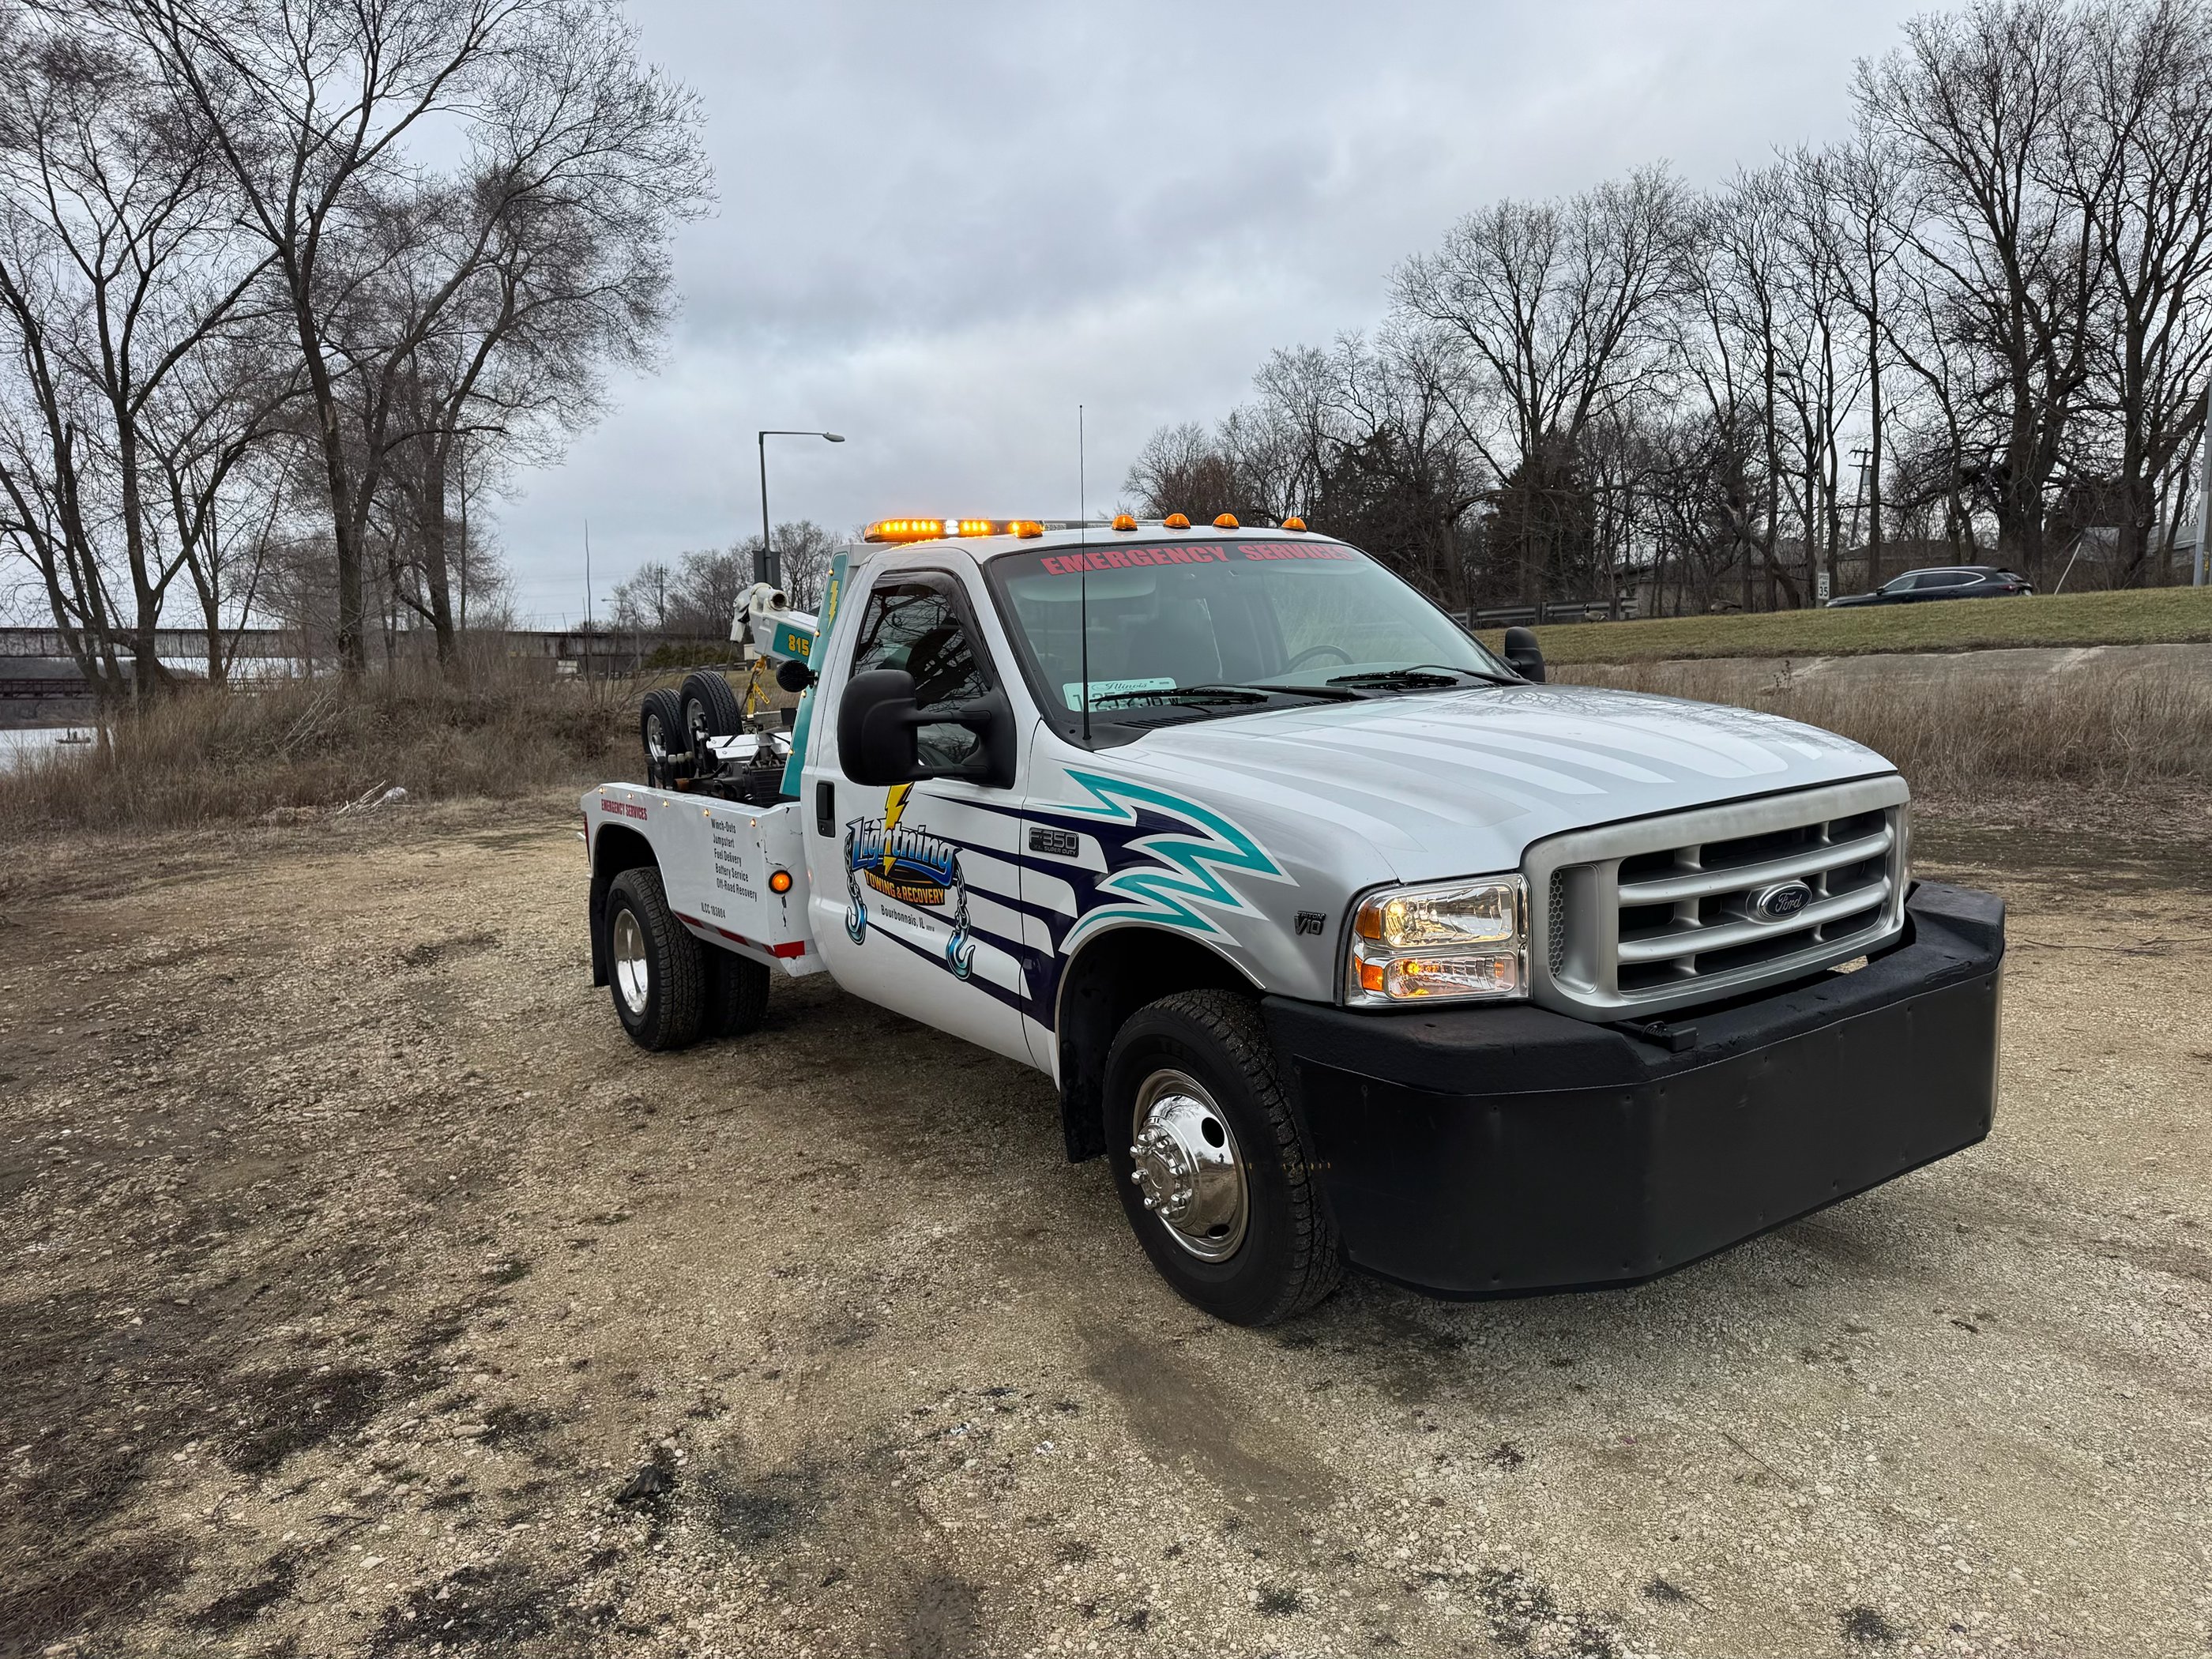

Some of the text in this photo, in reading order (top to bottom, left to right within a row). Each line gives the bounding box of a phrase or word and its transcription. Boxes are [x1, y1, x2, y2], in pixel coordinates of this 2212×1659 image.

[1040, 544, 1353, 575] EMERGENCY SERVICES
[1819, 586, 1828, 596] 35
[788, 634, 810, 656] 815
[601, 799, 648, 821] EMERGENCY SERVICES
[710, 818, 736, 834] Winch-Outs
[713, 833, 735, 848] Jumpstart
[714, 848, 742, 867] Fuel Delivery
[846, 816, 963, 890] Lightning
[715, 863, 749, 882] Battery Service
[717, 878, 758, 902] Off-Road Recovery
[864, 871, 896, 897] TOWING
[902, 886, 944, 903] RECOVERY
[1775, 891, 1803, 912] Ford
[881, 904, 925, 929] Bourbonnais, IL
[1294, 916, 1323, 935] V10
